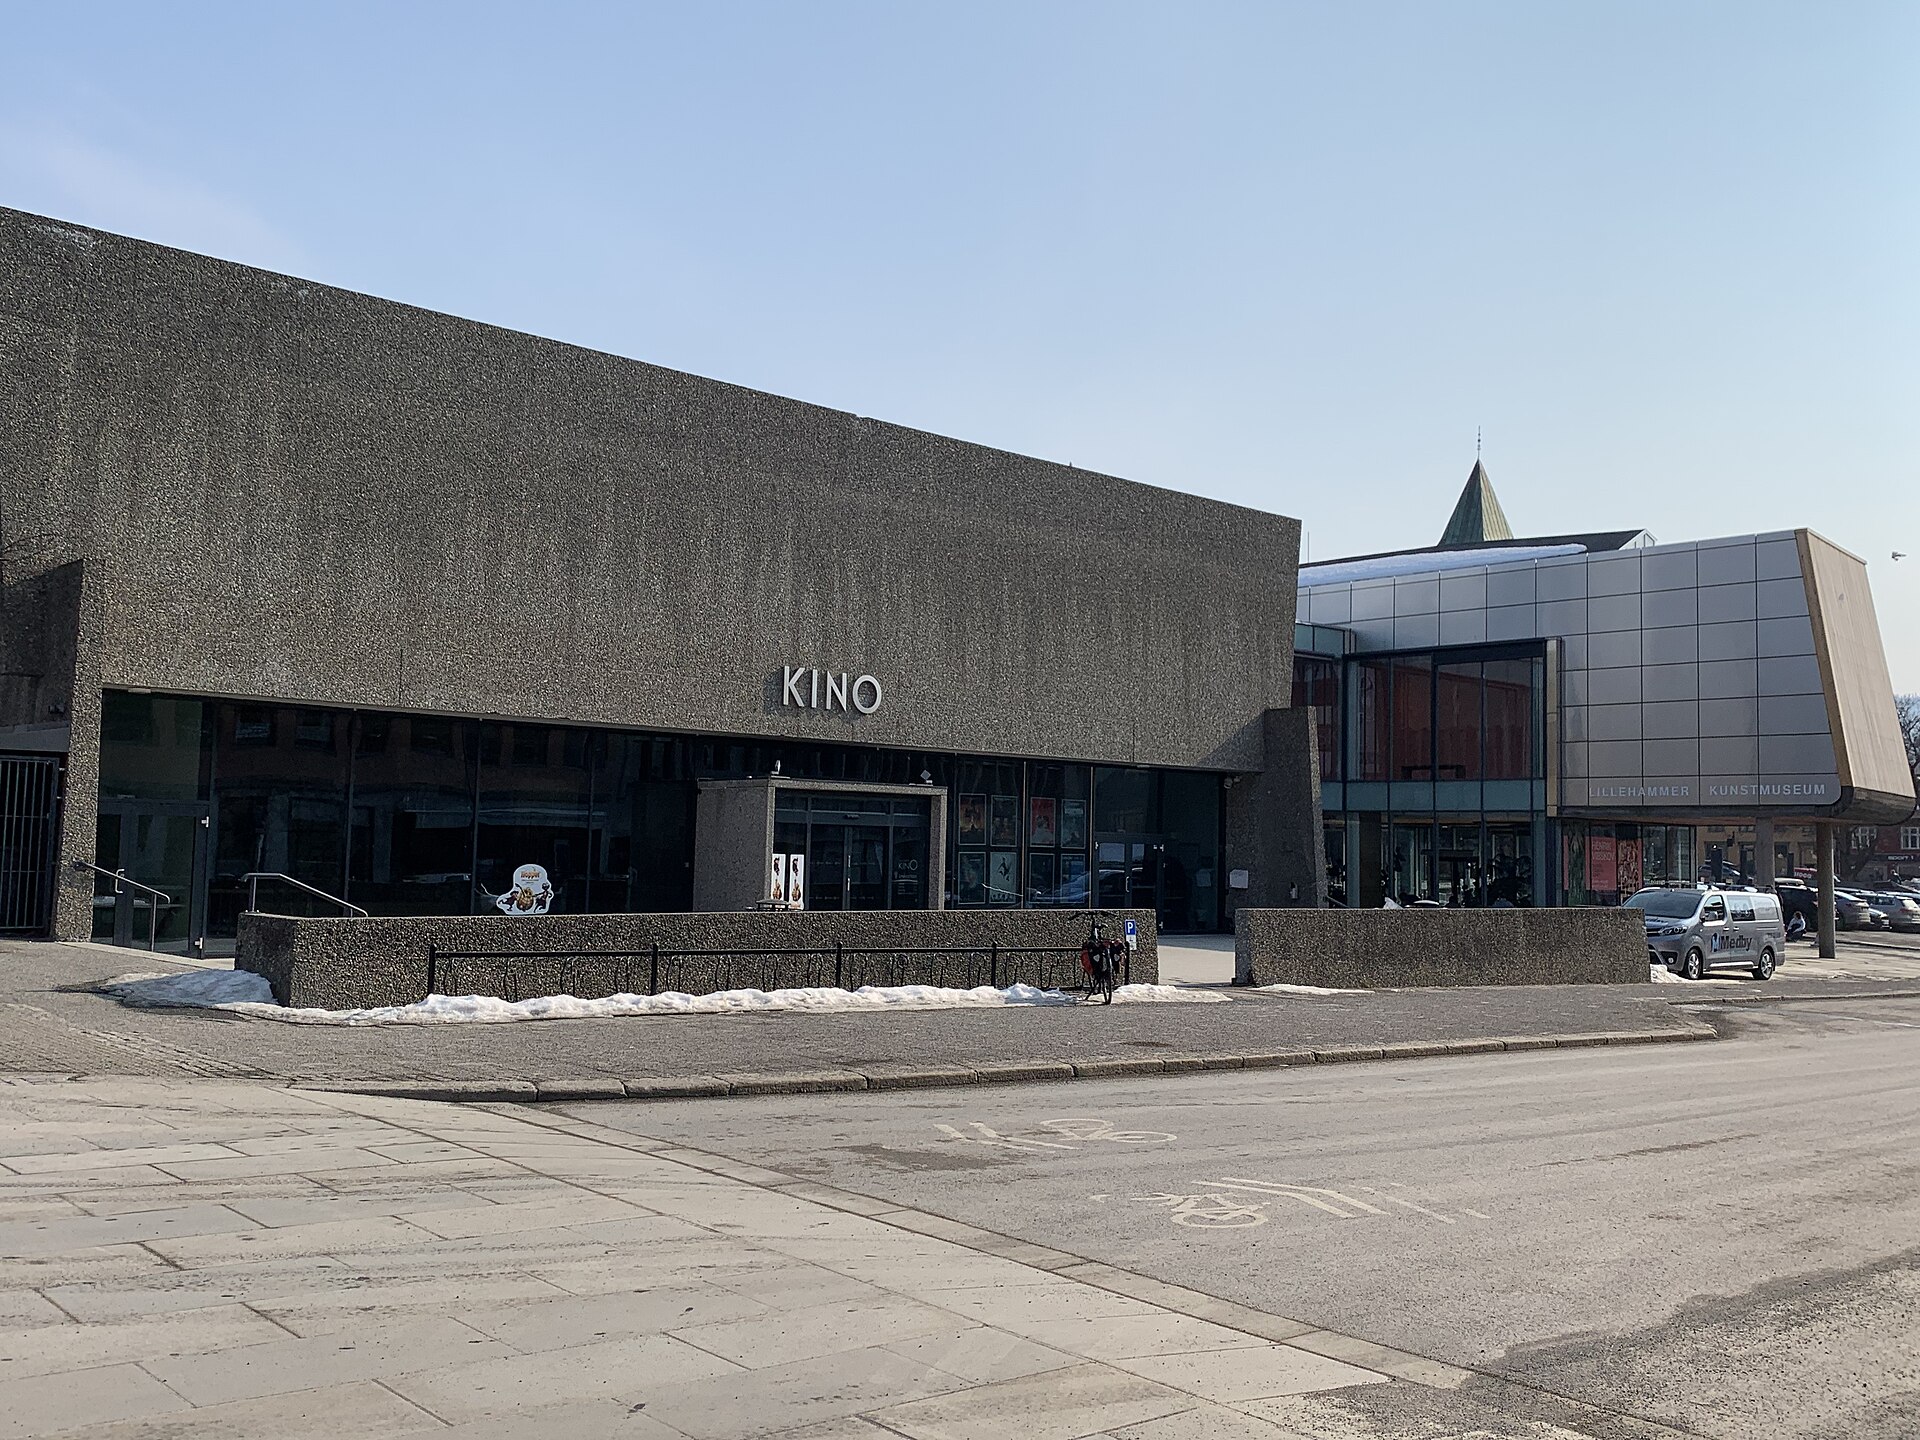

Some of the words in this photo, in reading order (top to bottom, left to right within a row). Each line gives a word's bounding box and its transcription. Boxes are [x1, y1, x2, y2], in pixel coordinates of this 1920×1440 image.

[783, 665, 882, 714] KINO
[1589, 786, 1690, 797] LILLEHAMMER
[1709, 784, 1826, 796] KUNSTMUSEUM
[1127, 921, 1134, 934] P
[1720, 934, 1752, 951] Medby
